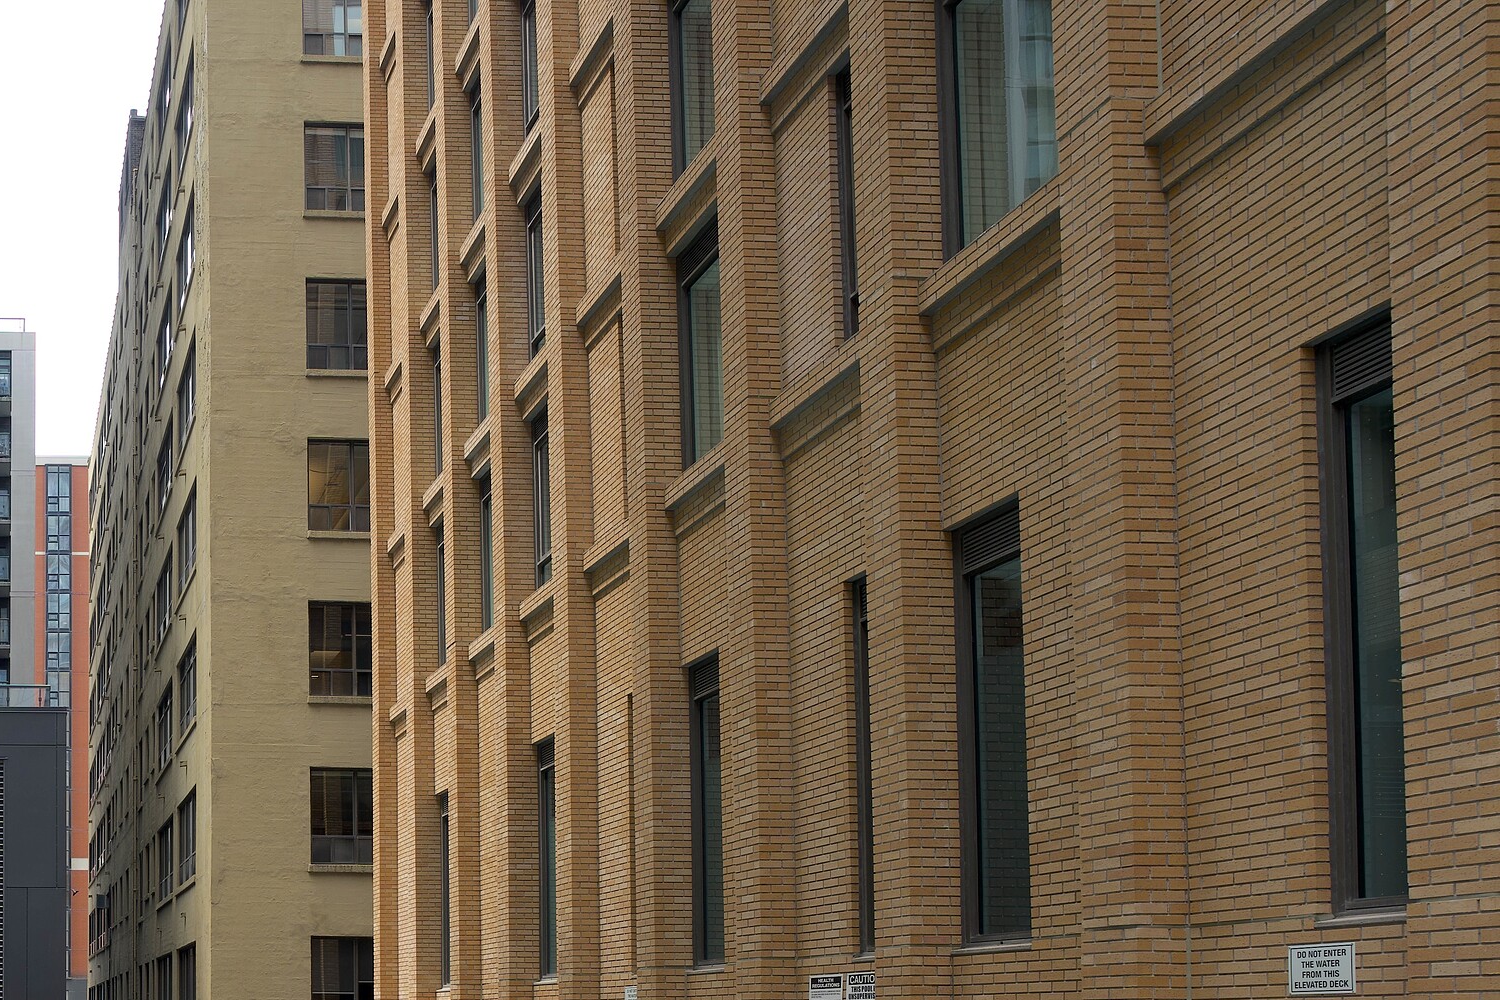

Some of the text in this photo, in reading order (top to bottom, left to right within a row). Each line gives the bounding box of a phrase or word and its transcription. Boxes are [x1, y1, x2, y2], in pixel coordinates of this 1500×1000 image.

[1308, 950, 1321, 958] NOT
[1324, 949, 1346, 957] ENTER
[1323, 970, 1340, 978] THIS
[850, 975, 875, 984] CAUTIO
[1295, 981, 1327, 989] ELEVATED
